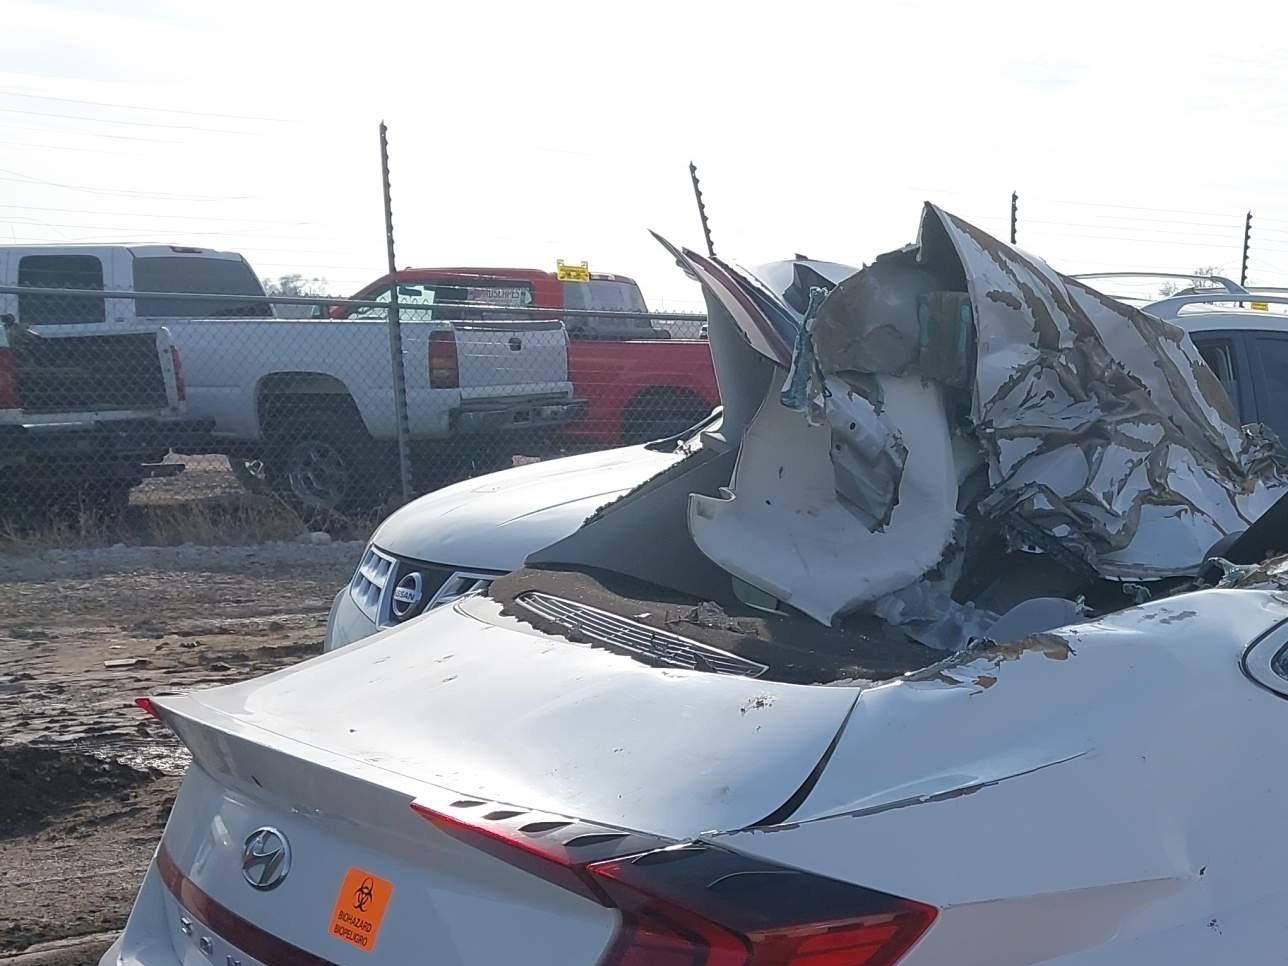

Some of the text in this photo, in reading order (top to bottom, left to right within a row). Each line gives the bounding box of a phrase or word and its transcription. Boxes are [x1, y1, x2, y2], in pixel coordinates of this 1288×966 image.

[395, 590, 415, 601] SSAN
[337, 910, 373, 933] BIOHAZARD
[333, 923, 368, 947] BIOPELIGRO
